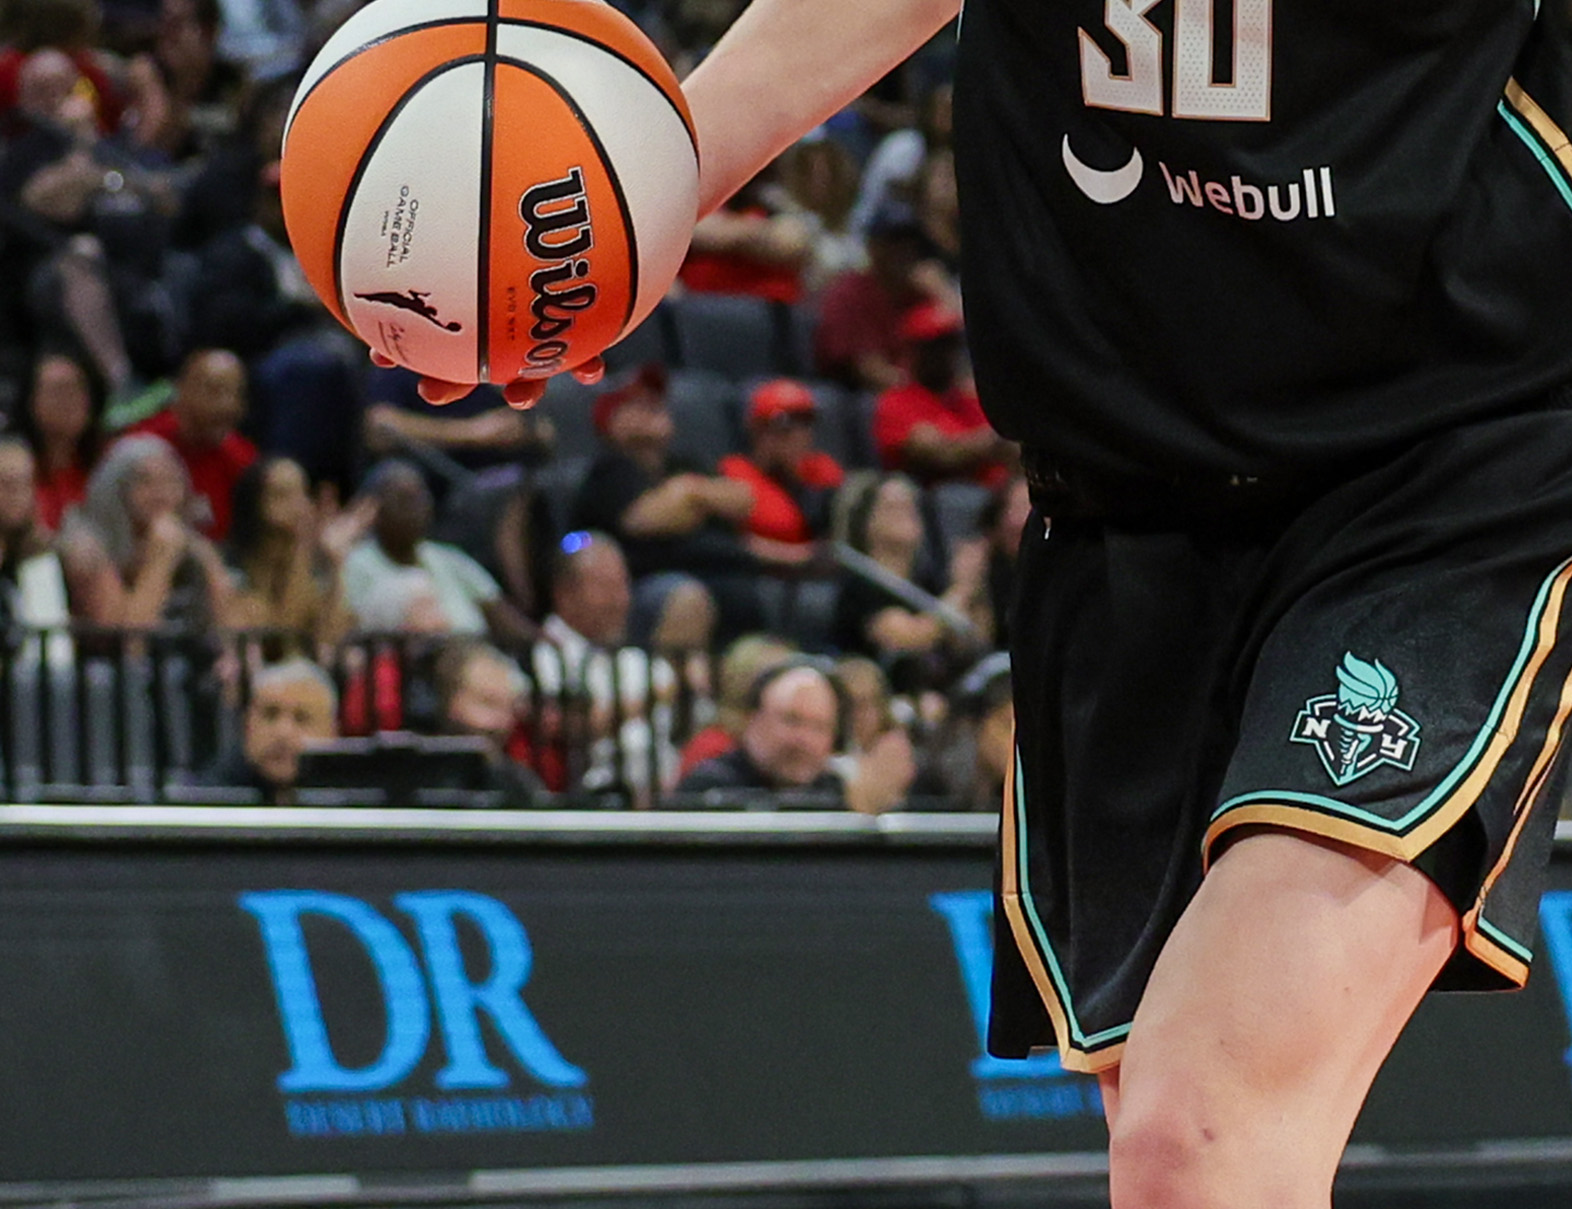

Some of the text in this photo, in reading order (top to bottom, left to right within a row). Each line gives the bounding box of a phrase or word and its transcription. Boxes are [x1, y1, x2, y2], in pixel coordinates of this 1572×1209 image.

[386, 184, 409, 268] GAME BALL
[1158, 160, 1337, 222] Webull
[399, 198, 419, 263] OFFICIAL
[238, 888, 590, 1094] DR
